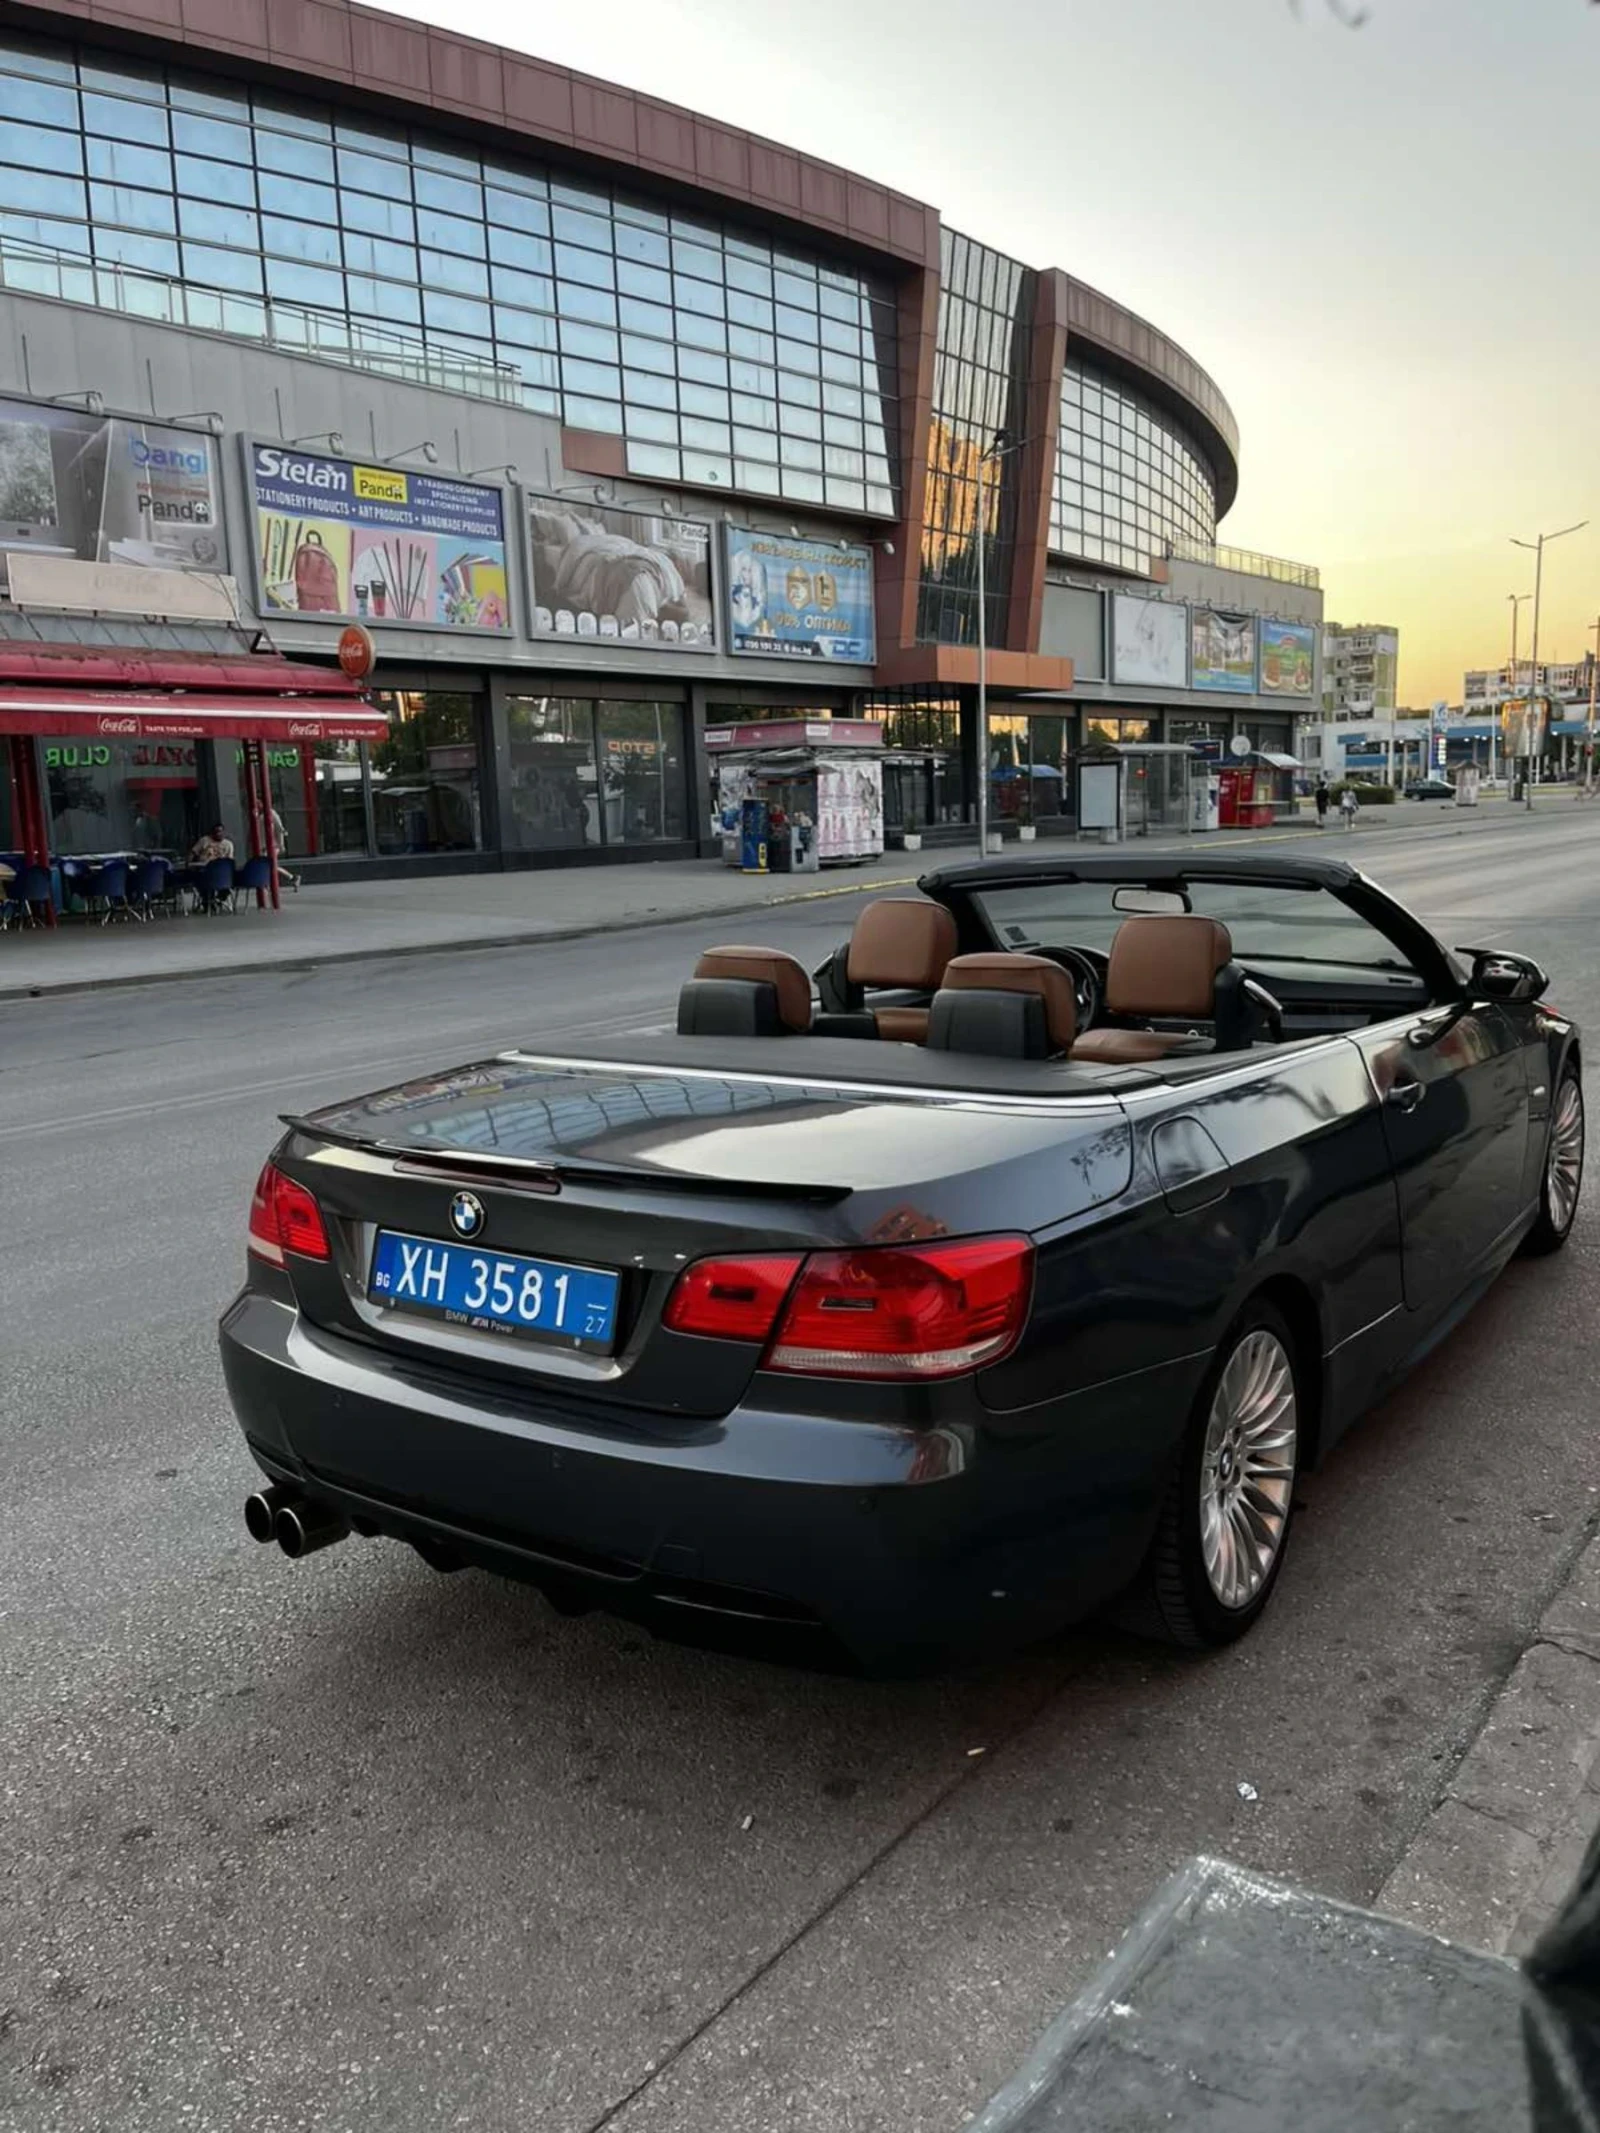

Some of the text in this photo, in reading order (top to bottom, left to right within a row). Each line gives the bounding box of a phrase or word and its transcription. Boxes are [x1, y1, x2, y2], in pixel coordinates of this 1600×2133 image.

[256, 449, 347, 491] Stelan
[256, 486, 306, 509] STATIONERY
[307, 496, 350, 515] PRODUCTS
[375, 507, 414, 524] PRODUCTS
[421, 514, 461, 532] HANDMADE
[462, 520, 498, 537] PRODUCTS
[375, 1271, 391, 1288] BG
[396, 1243, 570, 1328] XH 3581
[445, 1309, 469, 1324] BMW
[490, 1319, 515, 1335] Power
[584, 1315, 606, 1334] 27
